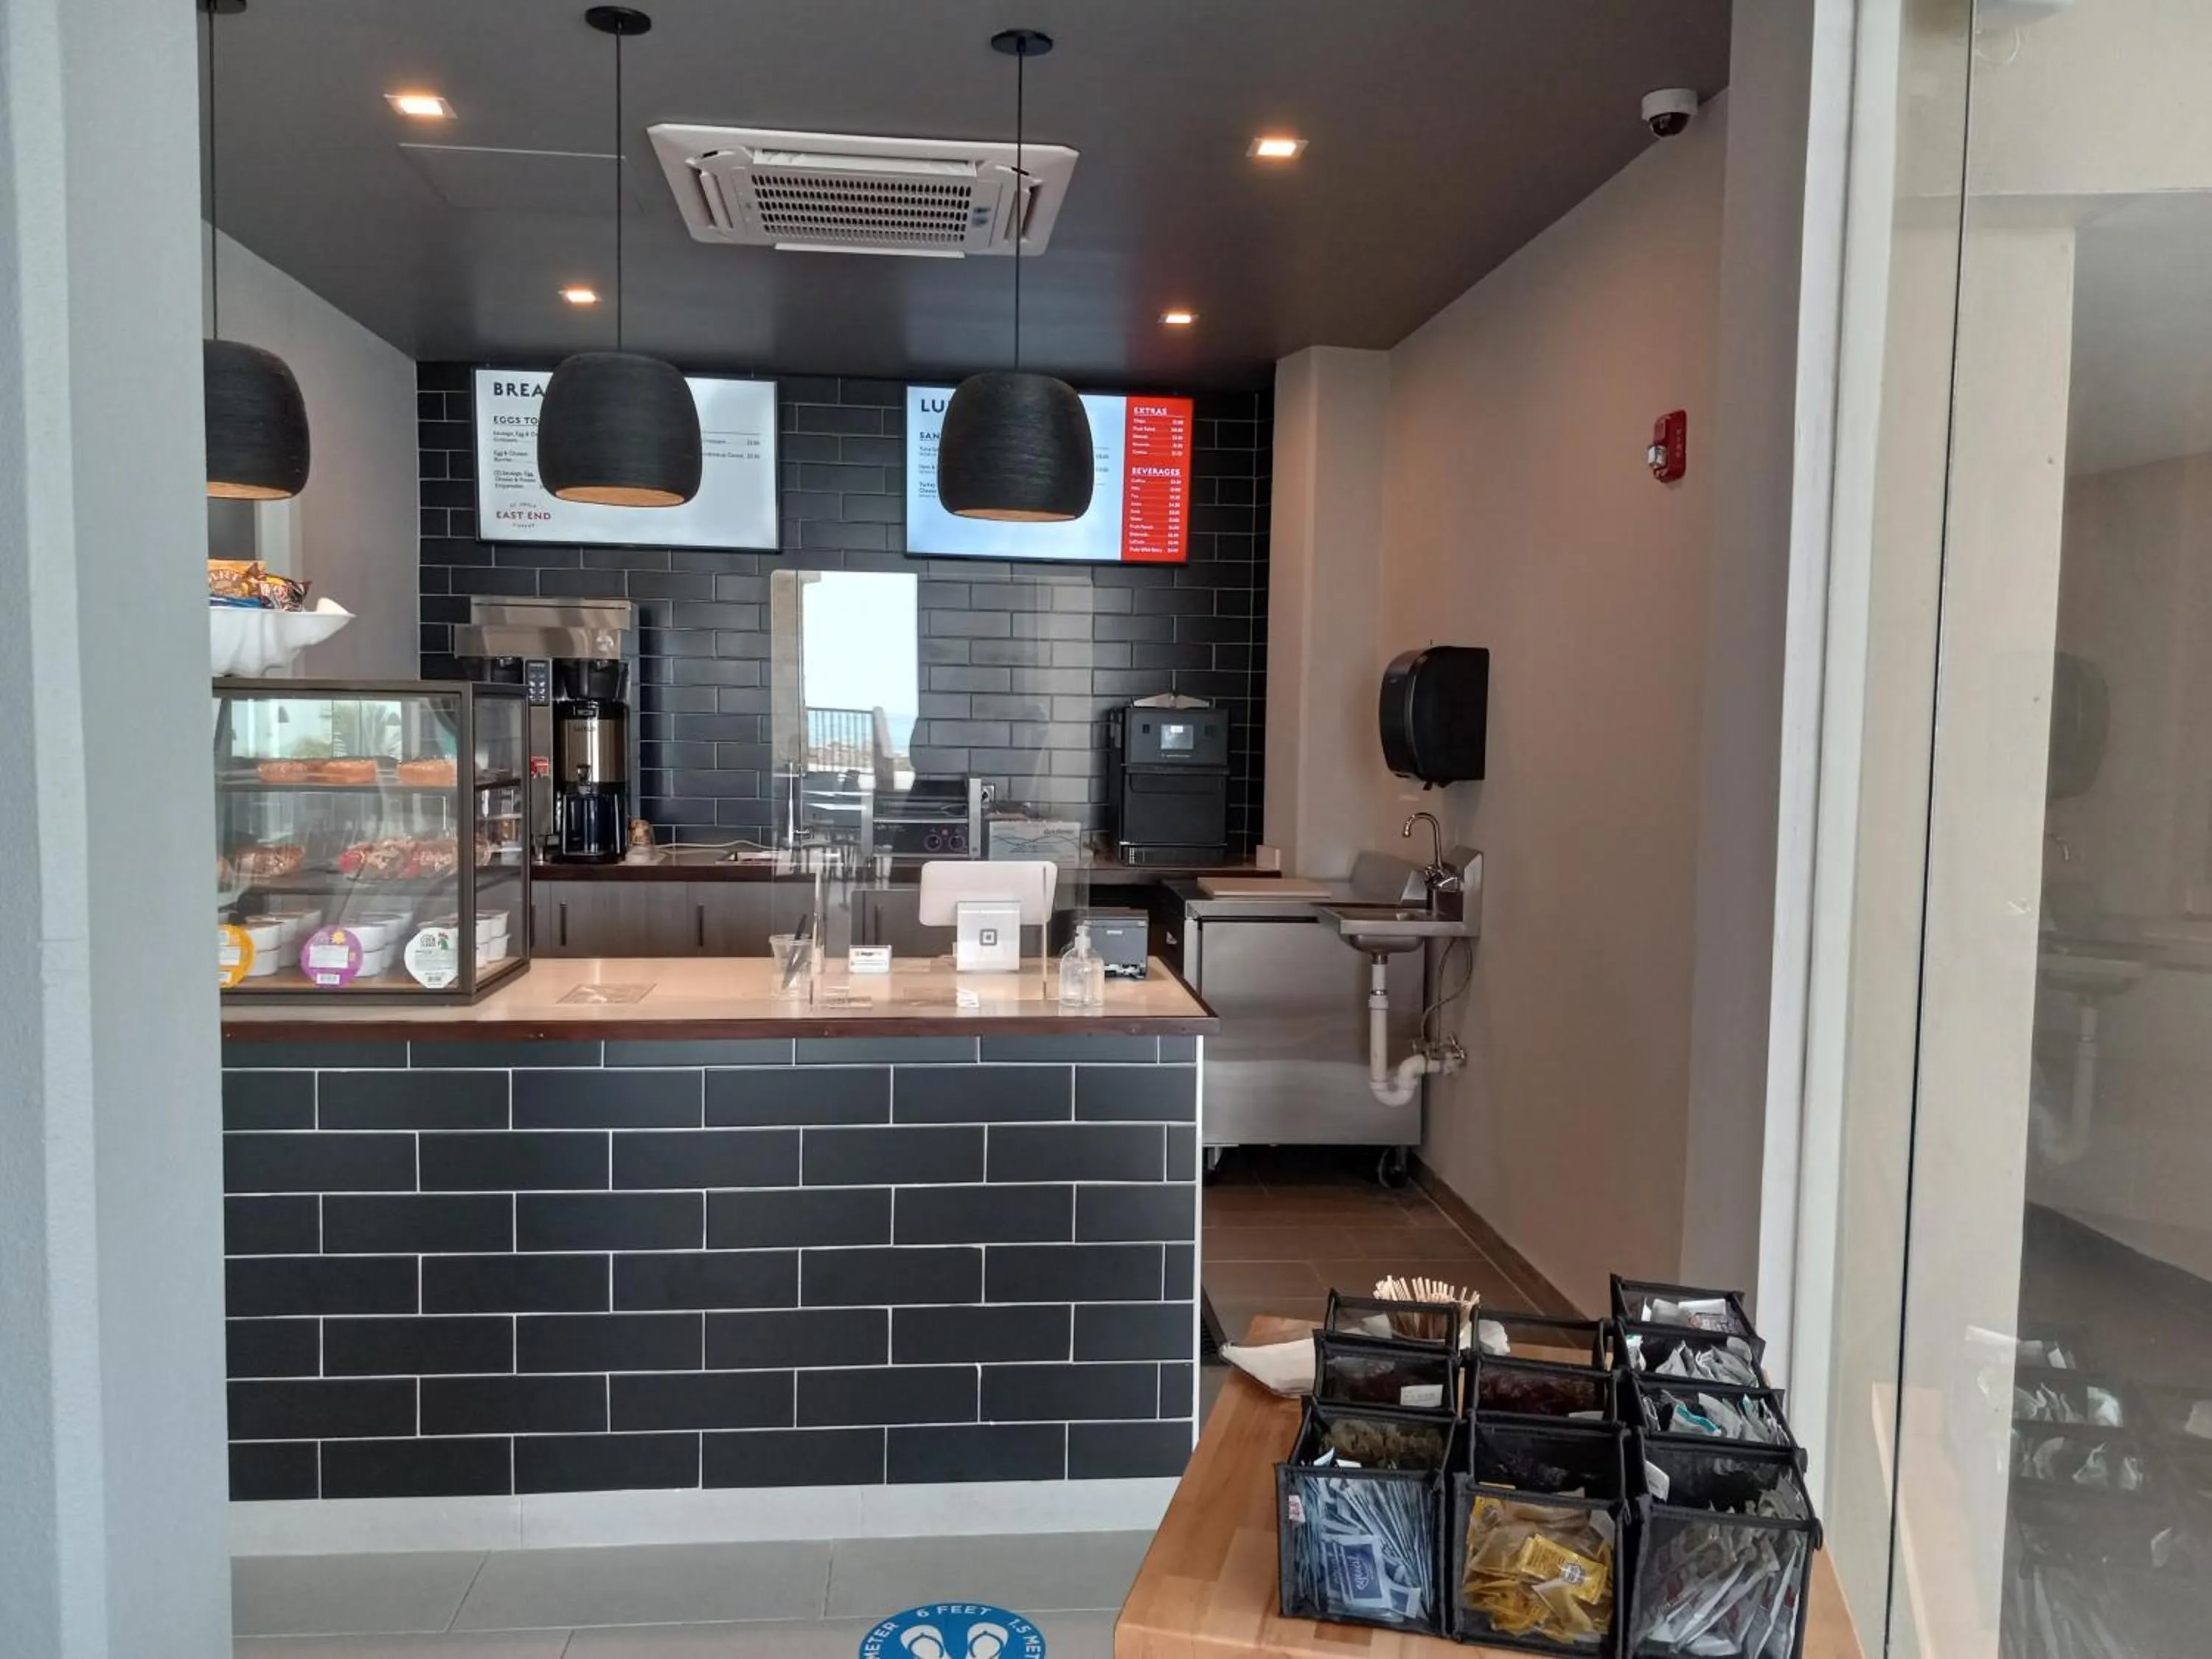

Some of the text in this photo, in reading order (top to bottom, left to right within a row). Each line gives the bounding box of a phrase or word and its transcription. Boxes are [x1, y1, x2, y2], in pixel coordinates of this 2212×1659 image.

[921, 399, 945, 413] LU
[1133, 407, 1167, 415] EXTRAS
[493, 415, 521, 424] EGGS
[1132, 467, 1180, 476] BEVERAGES
[496, 511, 551, 520] EAST END
[917, 1604, 992, 1618] 6 FEET
[1009, 1618, 1032, 1634] 1.5
